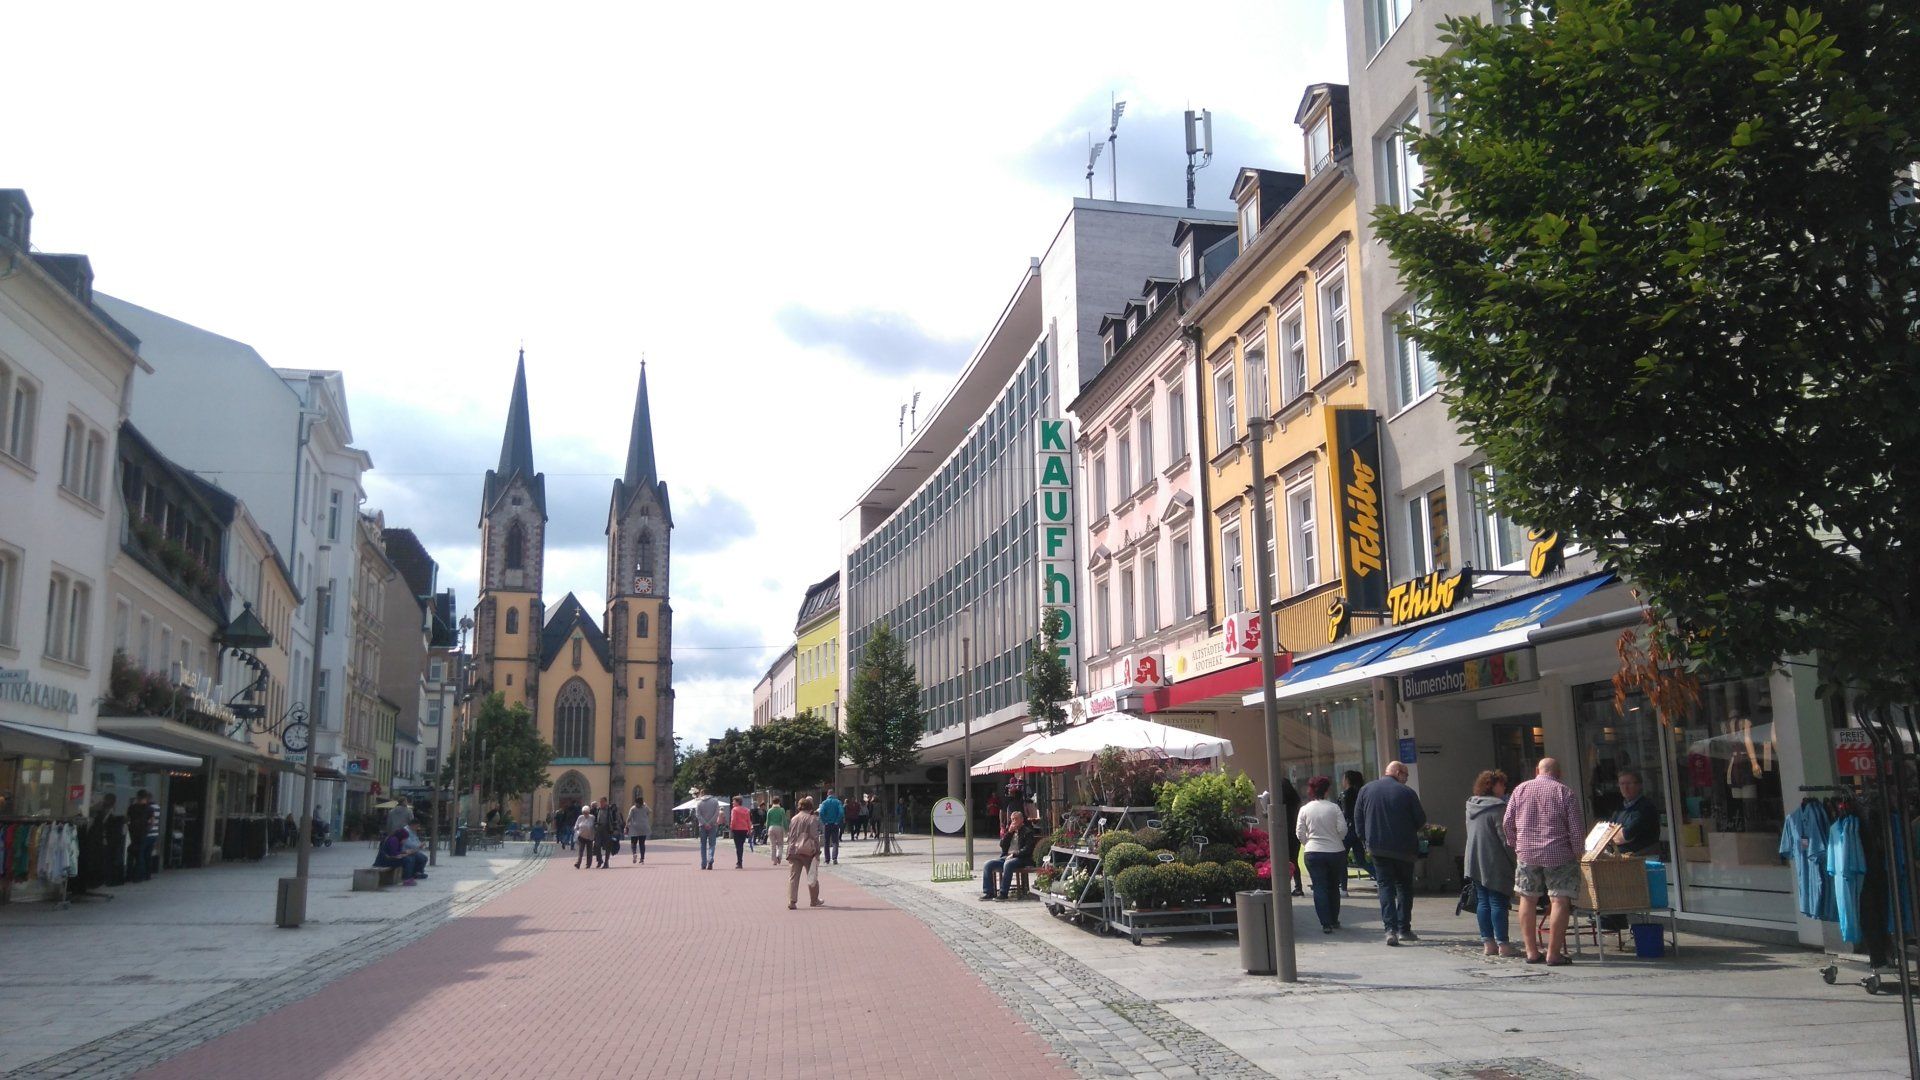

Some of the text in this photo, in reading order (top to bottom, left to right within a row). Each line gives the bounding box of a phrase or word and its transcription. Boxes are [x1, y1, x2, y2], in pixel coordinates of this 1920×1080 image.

[1348, 448, 1382, 578] Tchibo
[1387, 571, 1462, 626] Tchibo
[1191, 642, 1224, 661] ALTSTÄDTER
[1194, 654, 1223, 672] APOTHEKE
[1405, 669, 1466, 698] Blumenshop
[1840, 730, 1865, 738] PREIS
